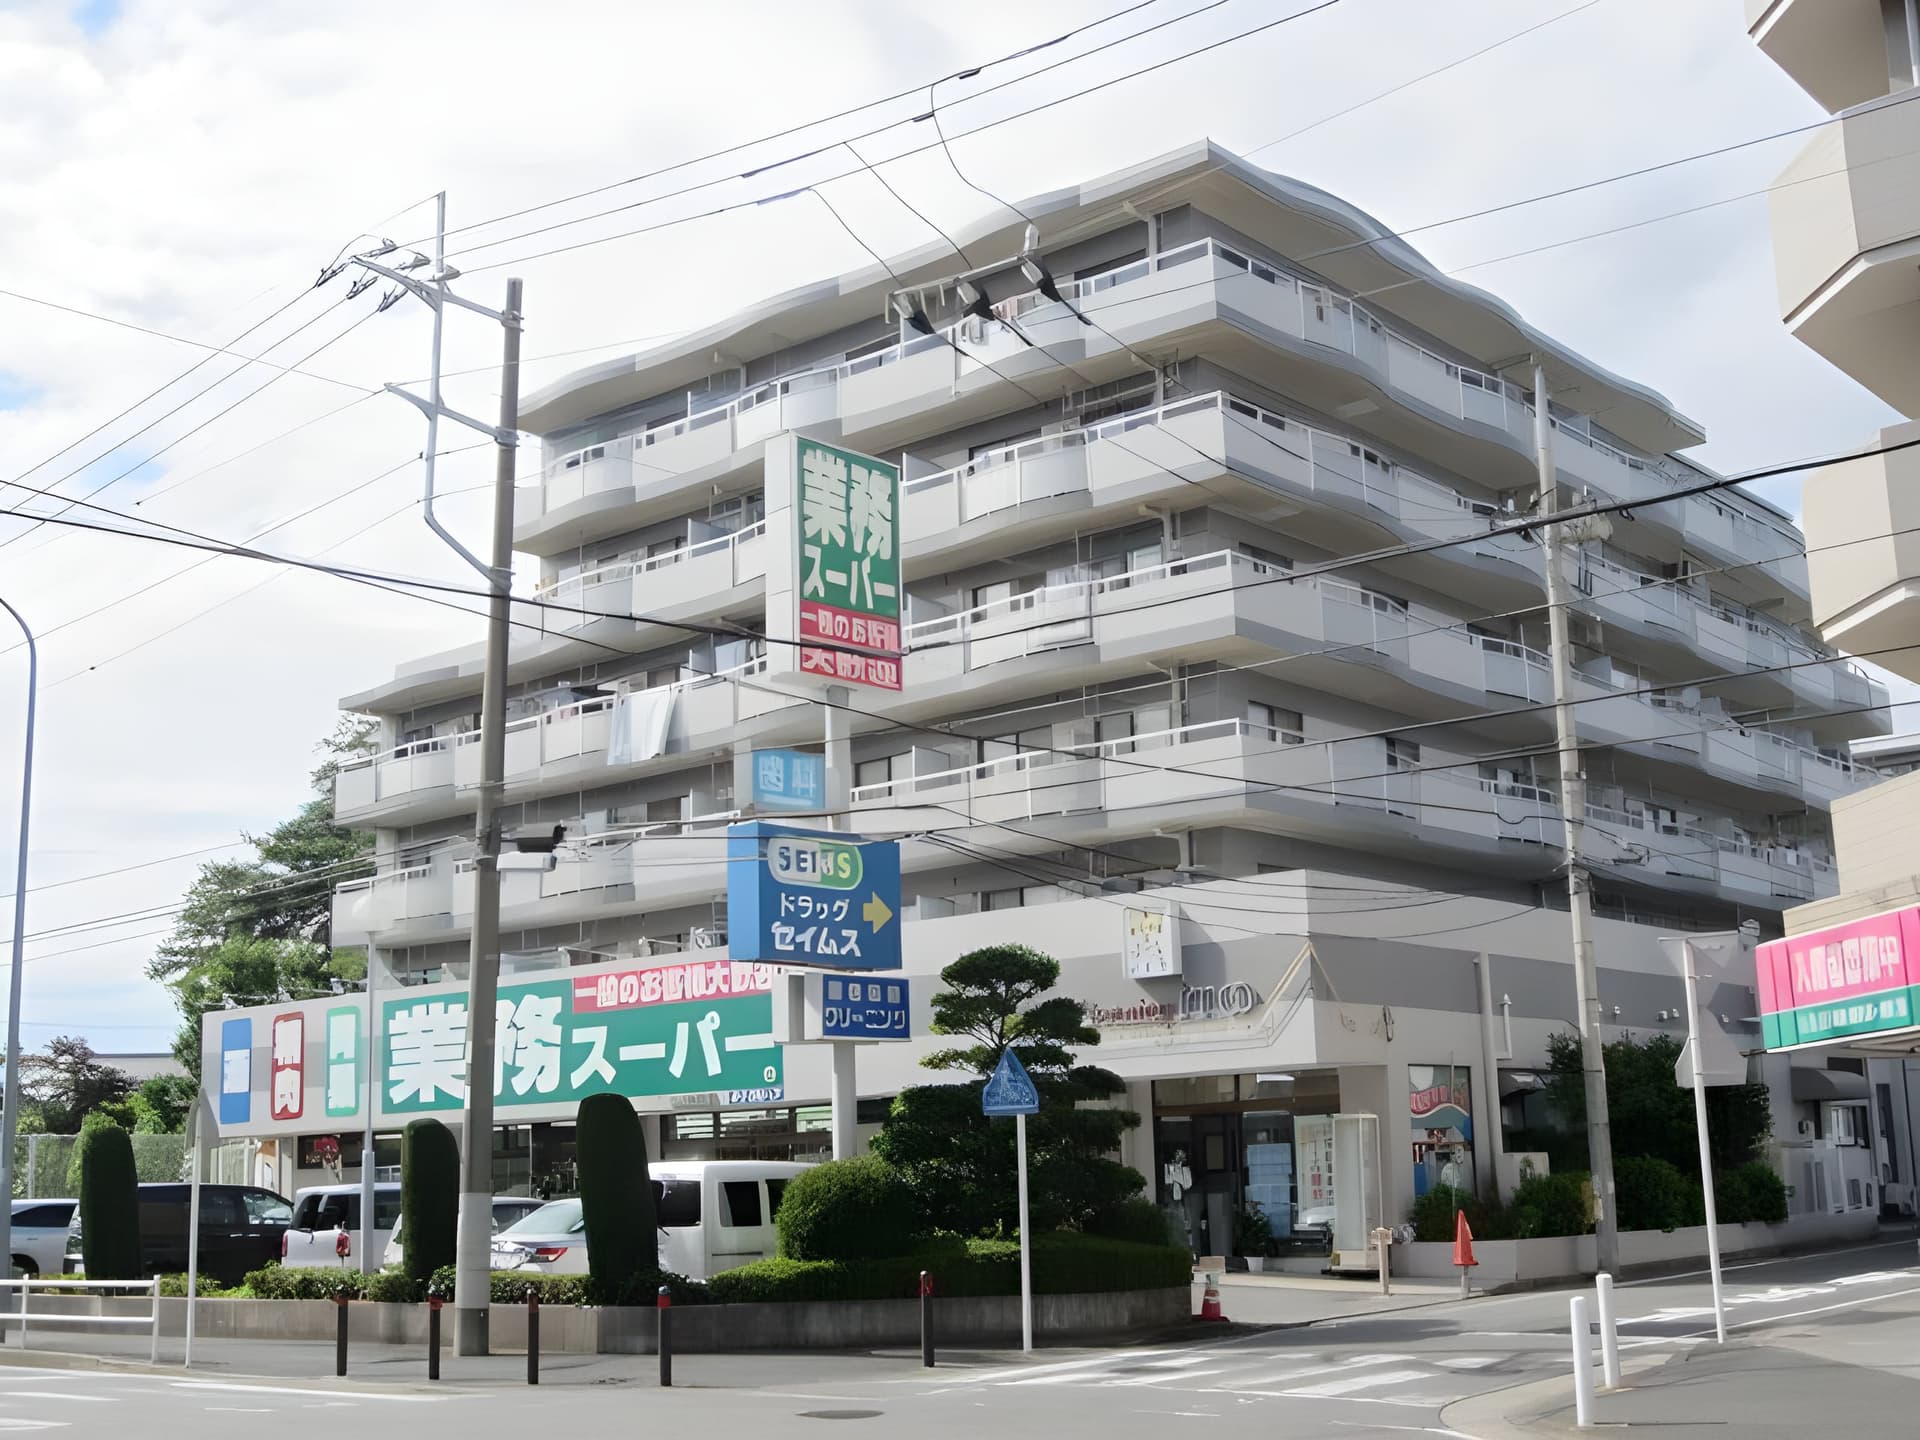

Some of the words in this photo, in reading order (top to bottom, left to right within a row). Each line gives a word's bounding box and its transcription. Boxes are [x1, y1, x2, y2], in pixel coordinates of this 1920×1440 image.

[781, 892, 850, 922] ドラッグ
[771, 920, 862, 958] セイムス
